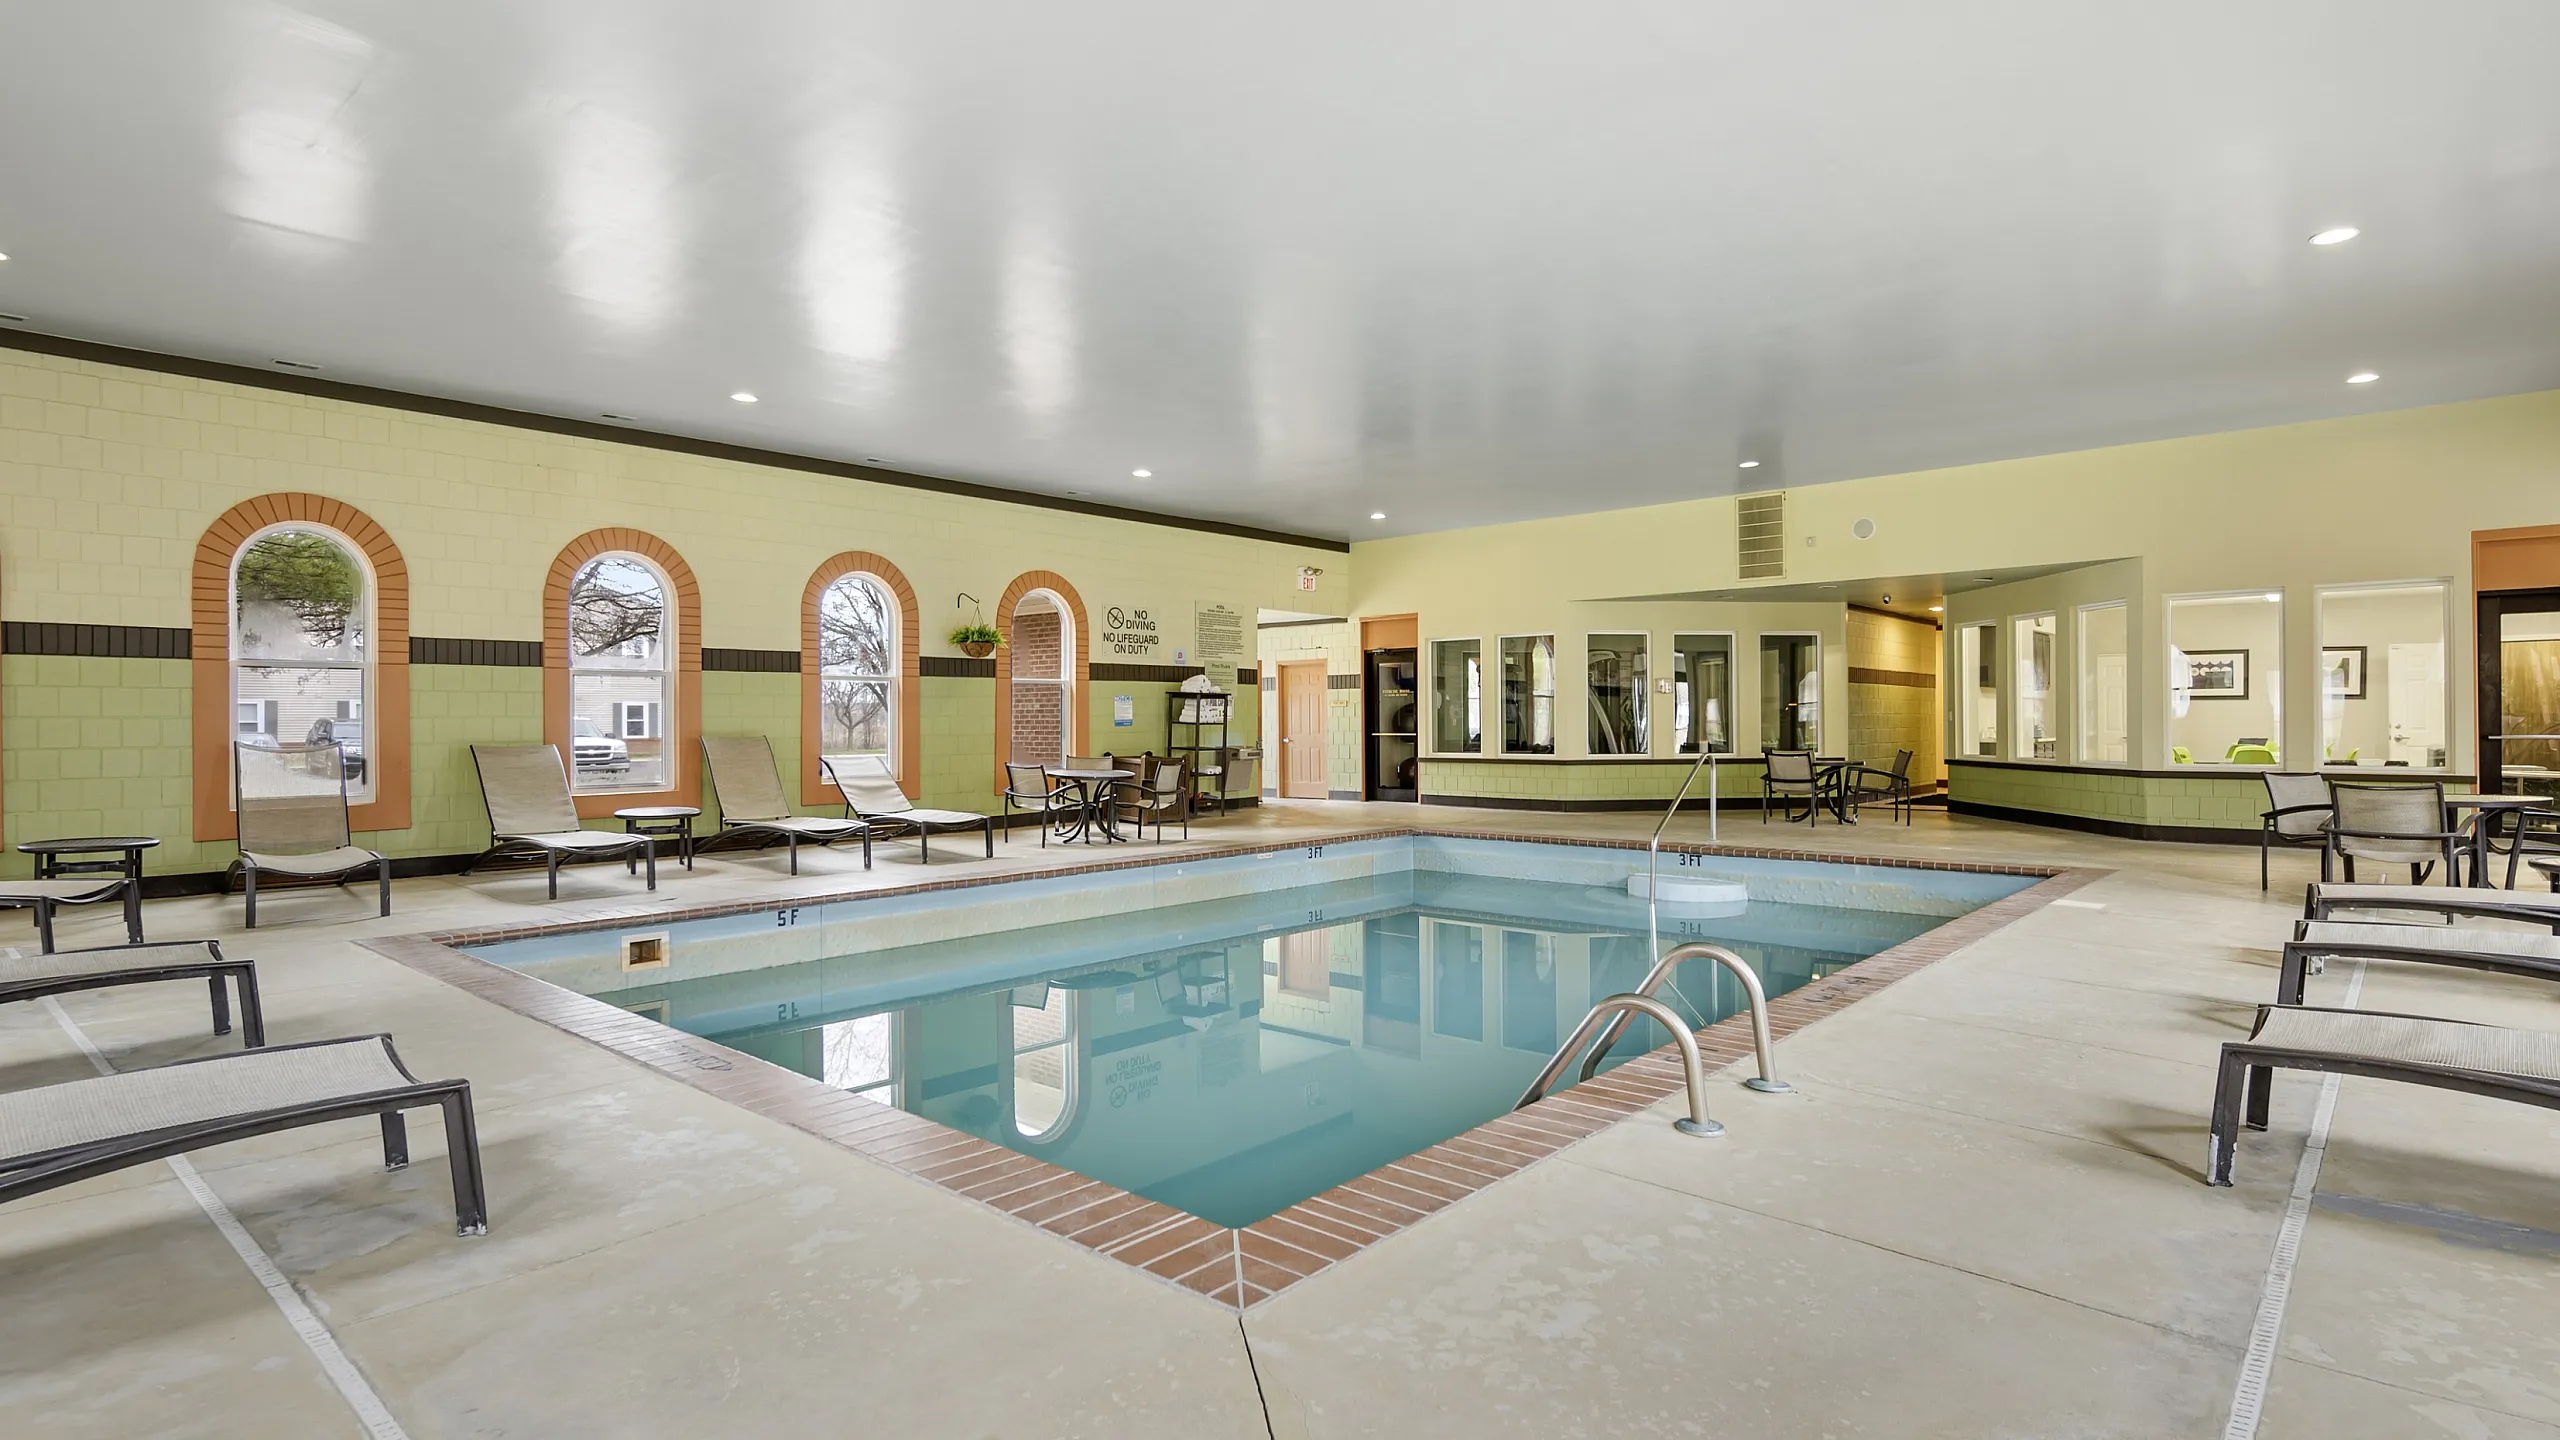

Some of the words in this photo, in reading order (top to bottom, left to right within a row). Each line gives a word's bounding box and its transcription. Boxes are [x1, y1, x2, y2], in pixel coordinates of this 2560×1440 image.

[1303, 577, 1313, 590] EXIT
[1134, 610, 1148, 620] NO
[1125, 620, 1156, 631] DIVING
[1103, 632, 1116, 642] NO
[1117, 633, 1159, 645] LIFEGUARD
[1114, 643, 1126, 654] ON
[1127, 644, 1149, 655] DUTY
[1308, 847, 1313, 858] 3
[1315, 846, 1323, 858] FT
[1679, 854, 1685, 865] 3
[1690, 855, 1702, 866] FT
[778, 910, 786, 926] 5
[791, 908, 799, 925] F
